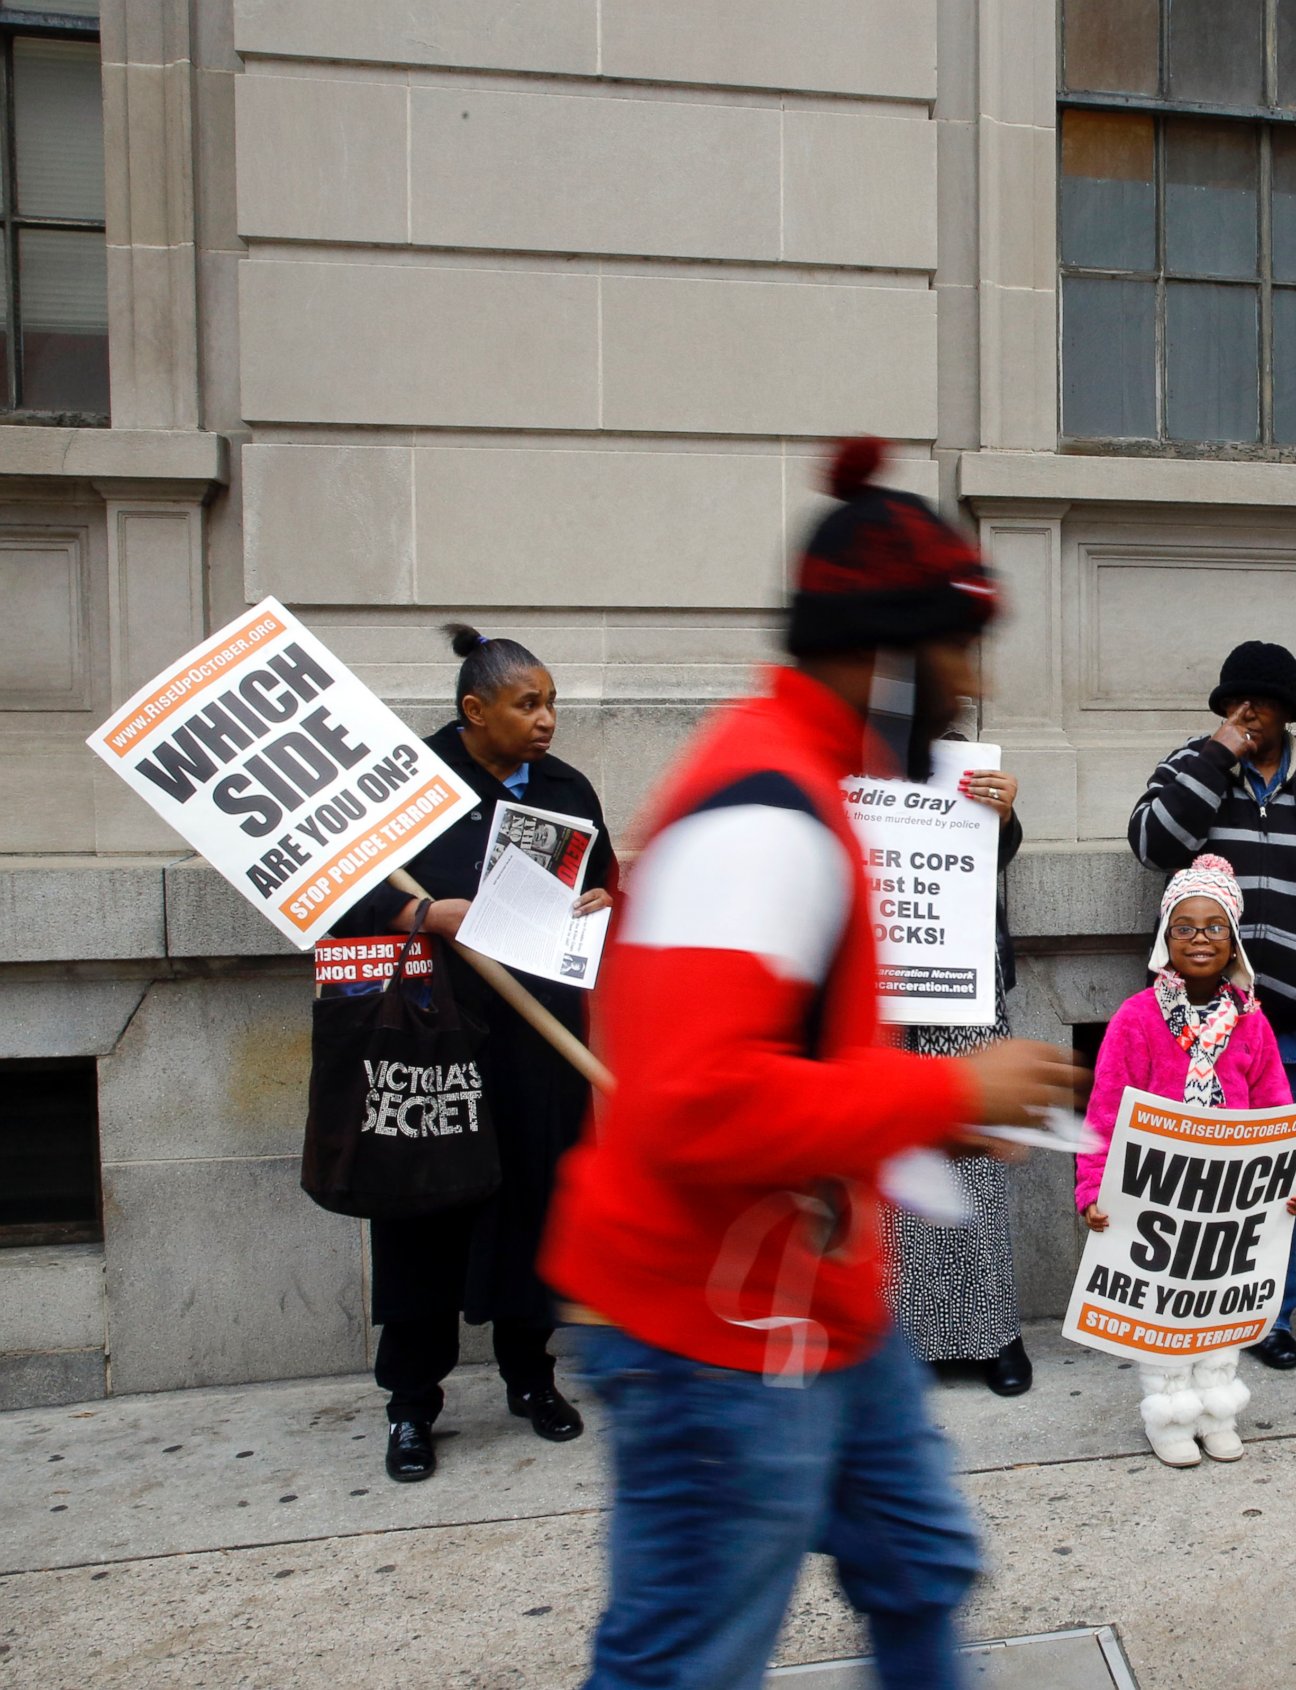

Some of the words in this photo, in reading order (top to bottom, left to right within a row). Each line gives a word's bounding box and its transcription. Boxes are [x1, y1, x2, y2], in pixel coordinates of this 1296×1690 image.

[134, 642, 335, 804] WHICH
[212, 705, 371, 837] SIDE
[841, 788, 896, 806] eddie
[904, 793, 957, 815] Gray
[246, 834, 312, 899] ARE
[295, 788, 367, 847] YOU
[357, 744, 419, 803] ON?
[854, 811, 882, 822] those
[885, 815, 932, 826] murdered
[935, 818, 947, 829] by
[949, 820, 980, 829] police
[289, 877, 331, 920] STOP
[327, 834, 387, 884] POLICE
[380, 784, 448, 842] TERROR!
[910, 852, 975, 872] COPS
[870, 876, 905, 893] ust
[914, 877, 941, 895] be
[880, 899, 940, 920] CELL
[873, 924, 945, 945] OCKS!
[362, 962, 399, 977] OPS
[405, 959, 433, 975] GOOD
[931, 970, 974, 980] Network
[361, 1088, 482, 1138] SECRET
[1130, 1210, 1267, 1280] SIDE
[1085, 1264, 1149, 1310] ARE
[1155, 1285, 1217, 1318] YOU
[1219, 1278, 1275, 1315] ON?
[1086, 1310, 1130, 1336] STOP
[1133, 1325, 1193, 1348] POLICE
[1196, 1324, 1260, 1348] TERROR!
